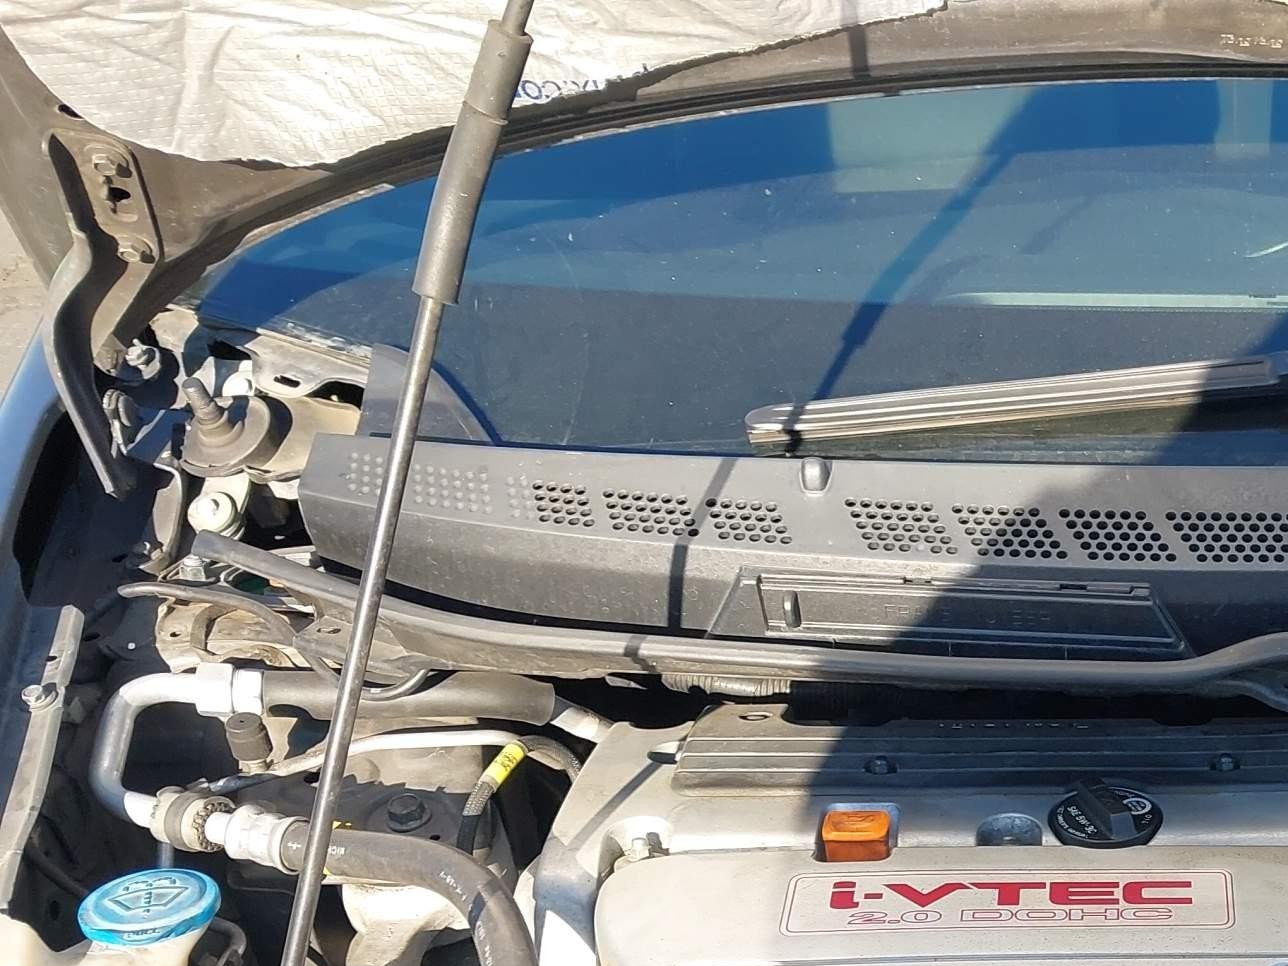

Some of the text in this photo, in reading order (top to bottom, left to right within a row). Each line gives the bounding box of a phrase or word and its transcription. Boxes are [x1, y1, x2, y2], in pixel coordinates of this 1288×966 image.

[830, 880, 1193, 909] i-VTEC
[847, 907, 1174, 926] 2.0 DOHC
